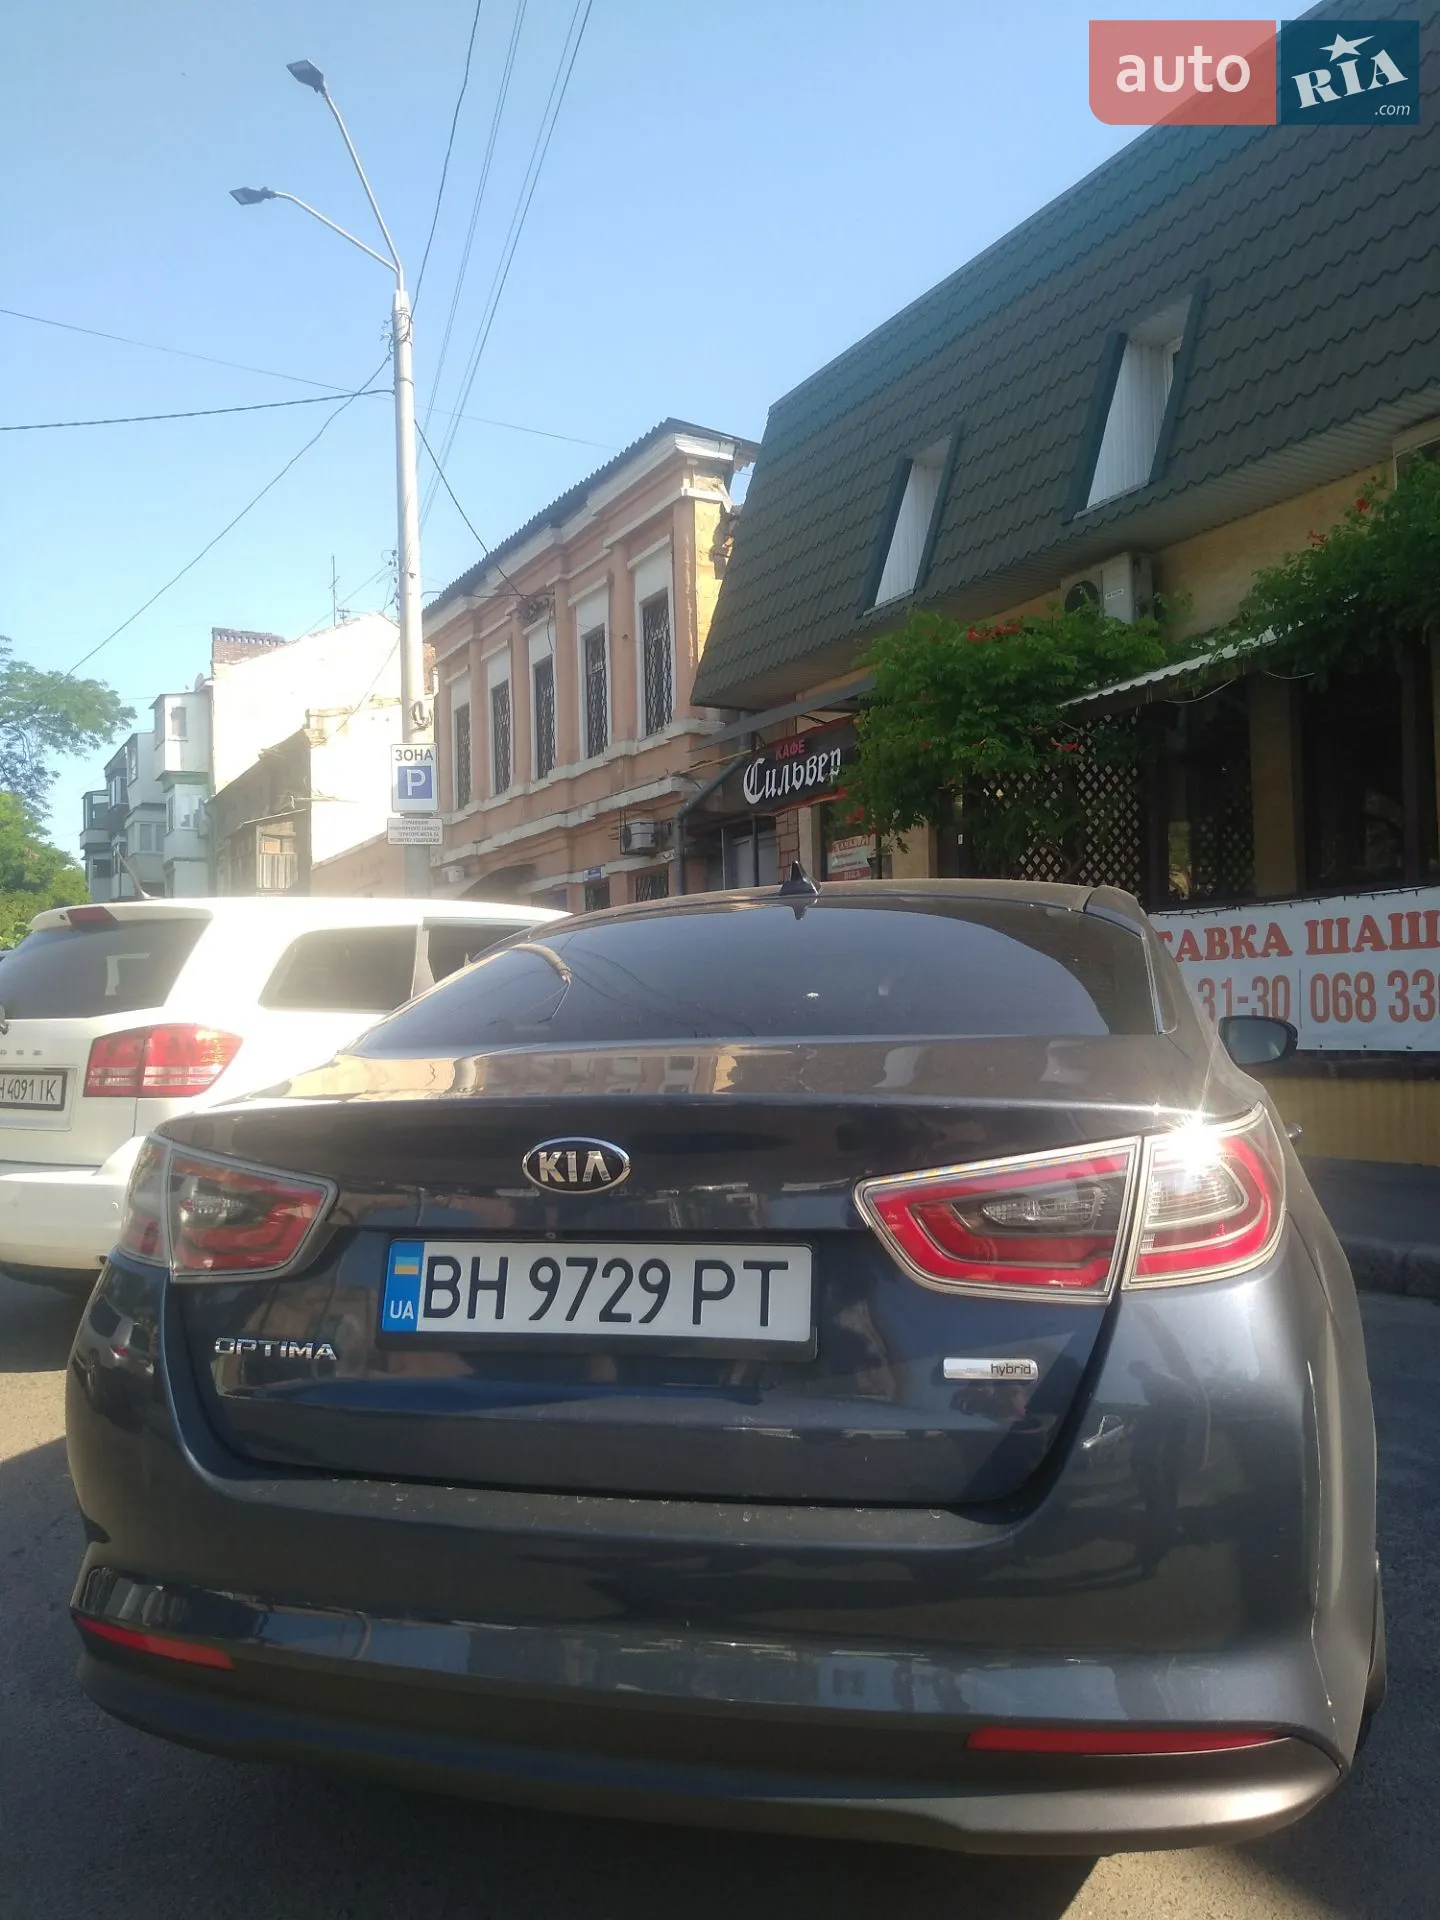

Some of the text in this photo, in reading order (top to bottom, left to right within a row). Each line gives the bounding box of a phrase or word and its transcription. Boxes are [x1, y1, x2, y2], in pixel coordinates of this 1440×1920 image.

[395, 749, 434, 761] ЗОНА
[775, 739, 805, 761] КАФЕ
[406, 769, 426, 796] P
[743, 747, 841, 804] Сильвер
[1304, 909, 1440, 956] ШАШ
[1197, 974, 1291, 1023] 31-30
[1310, 968, 1440, 1024] 068 33
[7, 1078, 35, 1100] 4091
[40, 1079, 57, 1101] IK
[538, 1150, 611, 1182] KIA
[422, 1256, 789, 1327] BH 9729 PT
[389, 1300, 414, 1320] UA
[214, 1337, 338, 1360] OPTIMA
[990, 1363, 1031, 1376] hybrid
